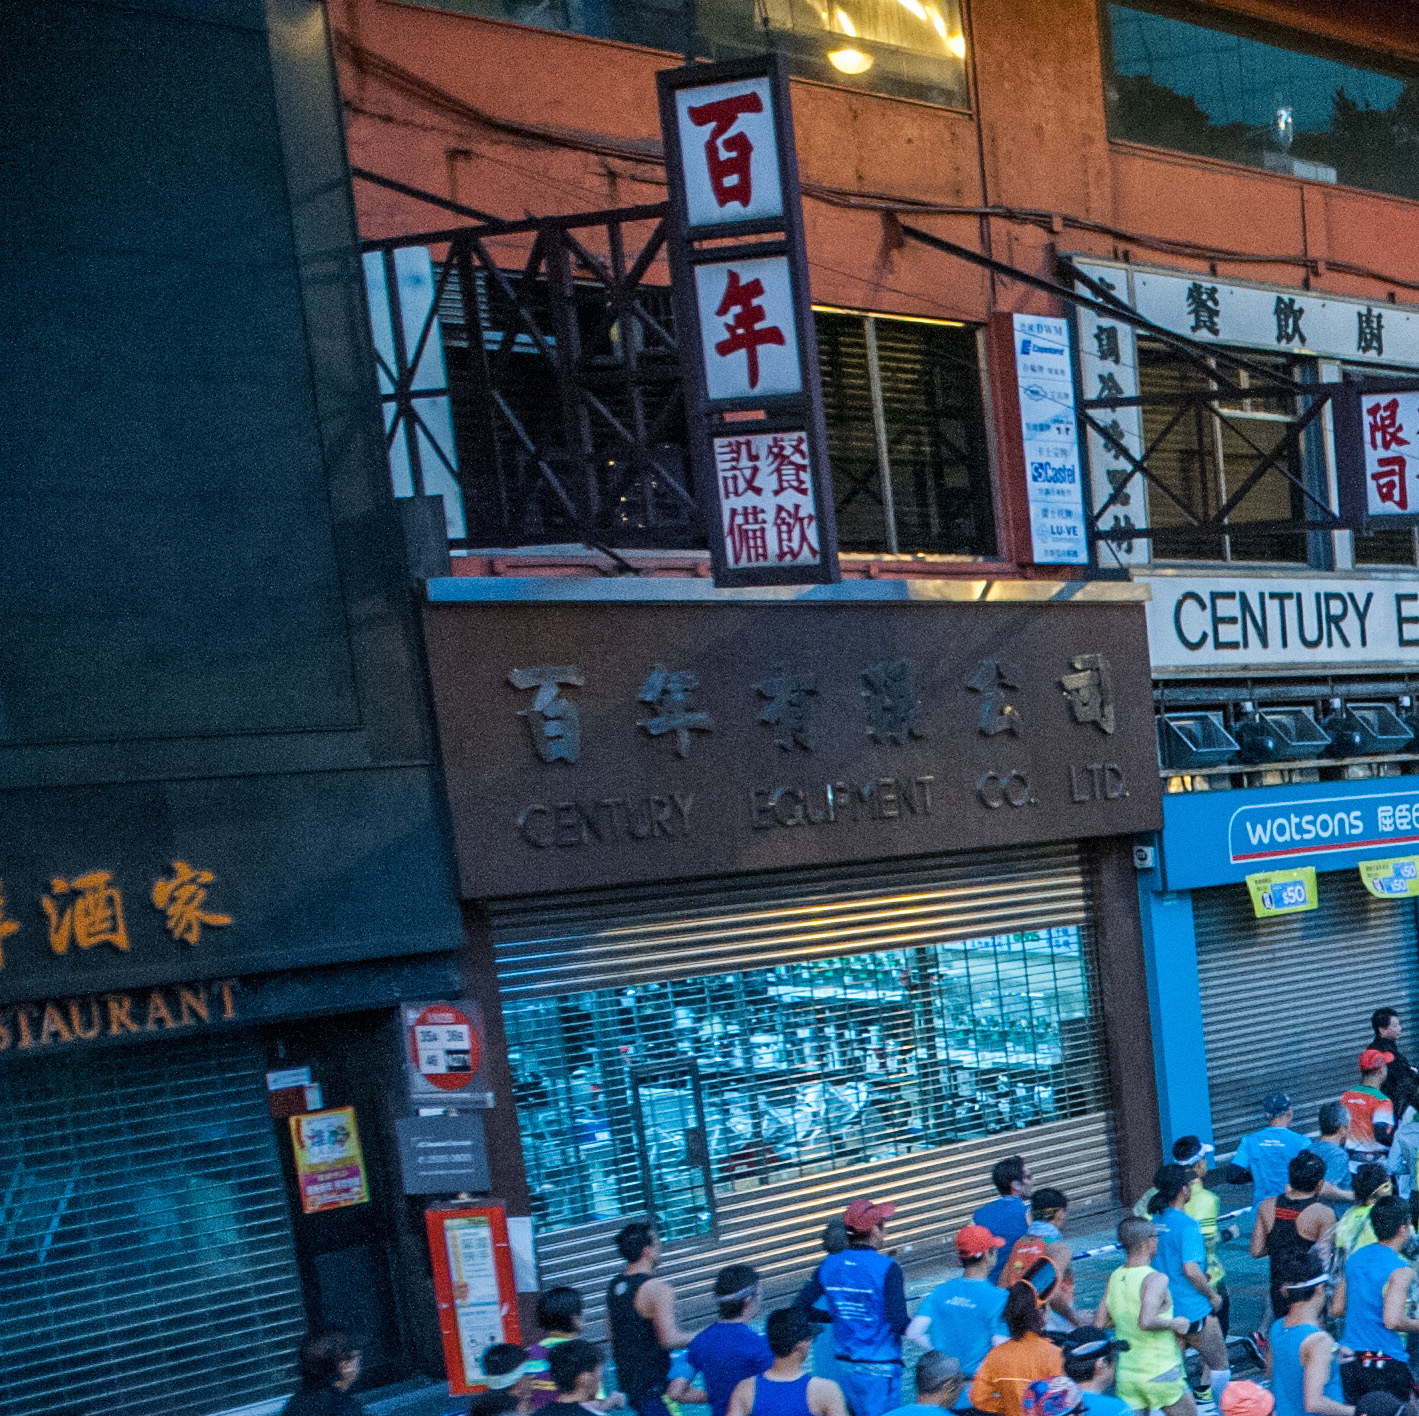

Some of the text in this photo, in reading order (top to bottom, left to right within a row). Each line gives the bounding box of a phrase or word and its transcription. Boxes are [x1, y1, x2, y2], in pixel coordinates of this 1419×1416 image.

[1174, 592, 1371, 650] CENTURY
[517, 795, 697, 849] CENTURY
[749, 775, 935, 831] EQUIPMENT
[1246, 810, 1364, 846] watsons
[1282, 885, 1305, 905] $50
